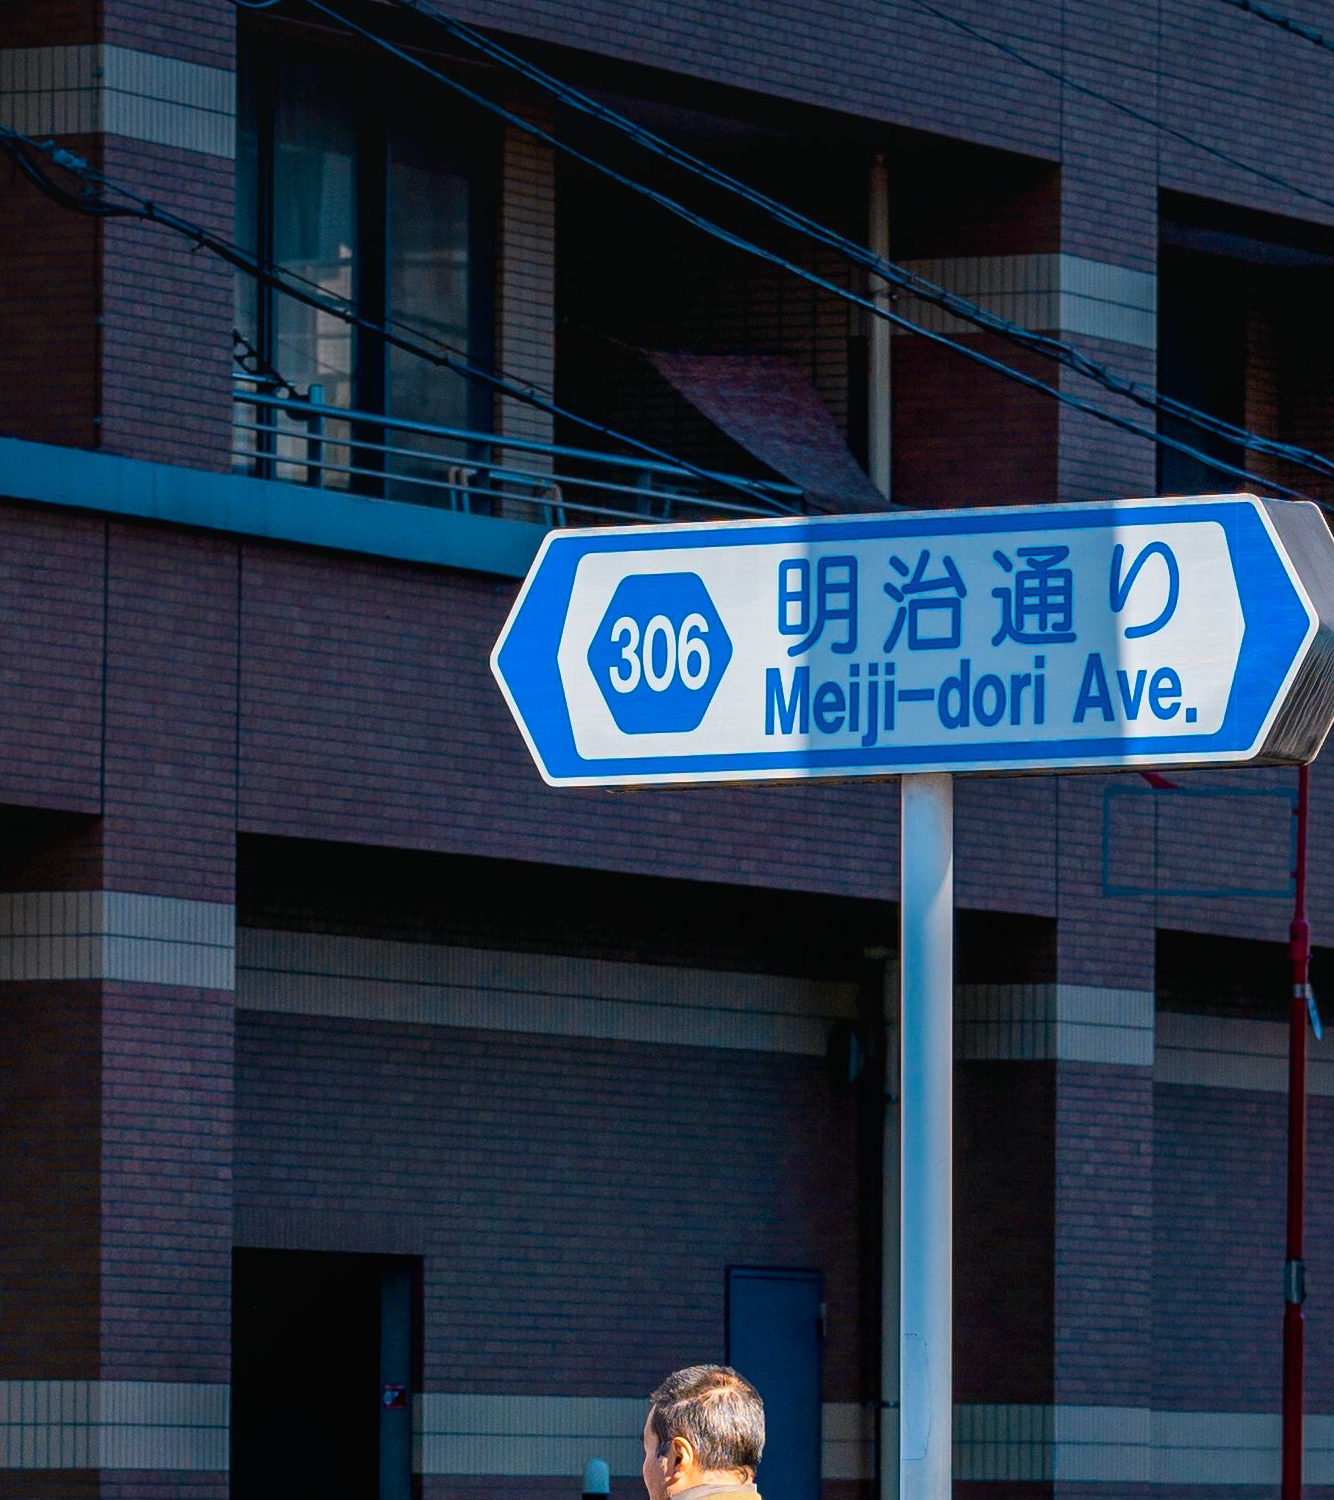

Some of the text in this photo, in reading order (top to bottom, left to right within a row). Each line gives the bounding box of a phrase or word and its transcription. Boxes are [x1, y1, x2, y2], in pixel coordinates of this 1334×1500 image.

[777, 541, 1181, 658] 明治通り
[609, 614, 711, 694] 306
[764, 652, 1199, 748] Meiji-dori Ave.
